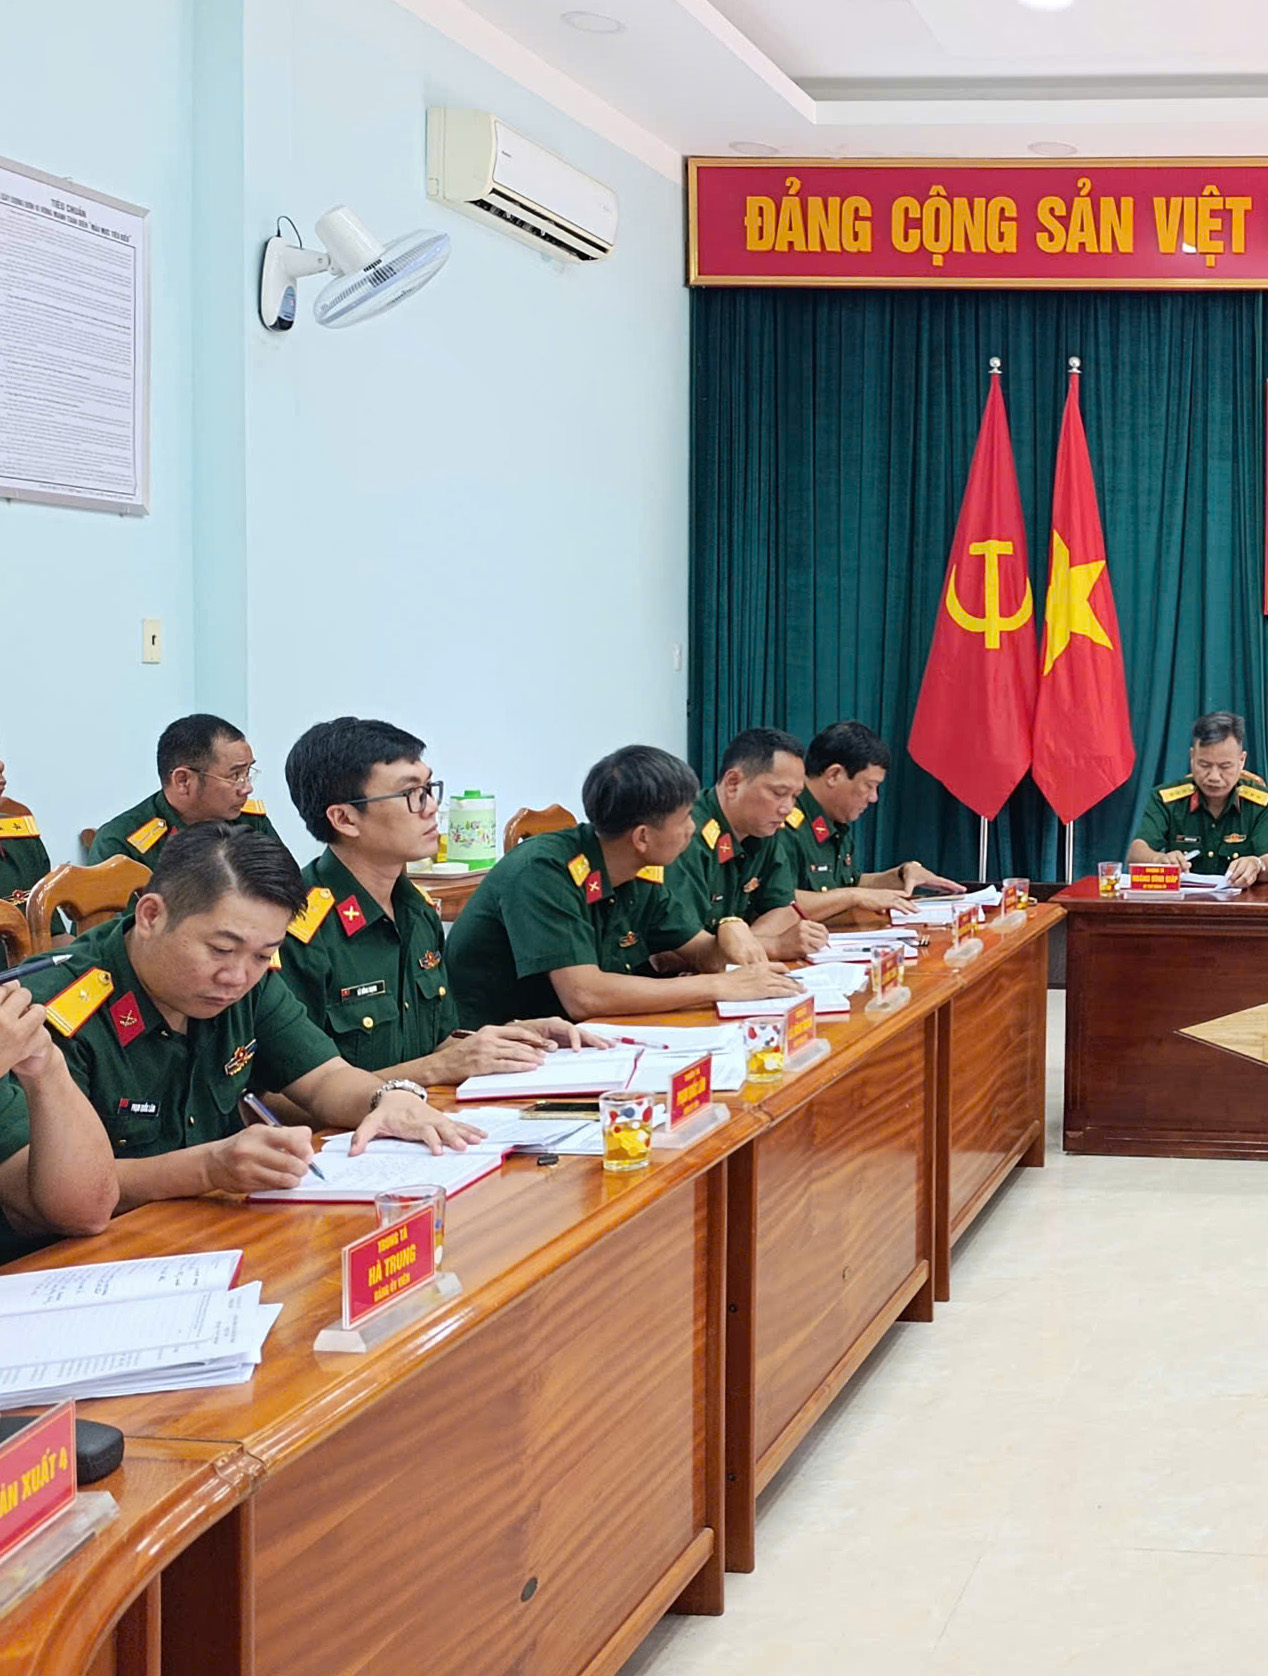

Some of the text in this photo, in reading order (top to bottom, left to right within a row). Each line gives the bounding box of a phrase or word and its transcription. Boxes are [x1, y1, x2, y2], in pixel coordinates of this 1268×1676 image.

[744, 176, 872, 253] ĐẢNG
[891, 185, 1018, 266] CỘNG
[1036, 178, 1134, 253] SẢN
[1153, 185, 1252, 267] VIỆT
[384, 1243, 416, 1277] TRUNG
[21, 1447, 57, 1501] XUẤT
